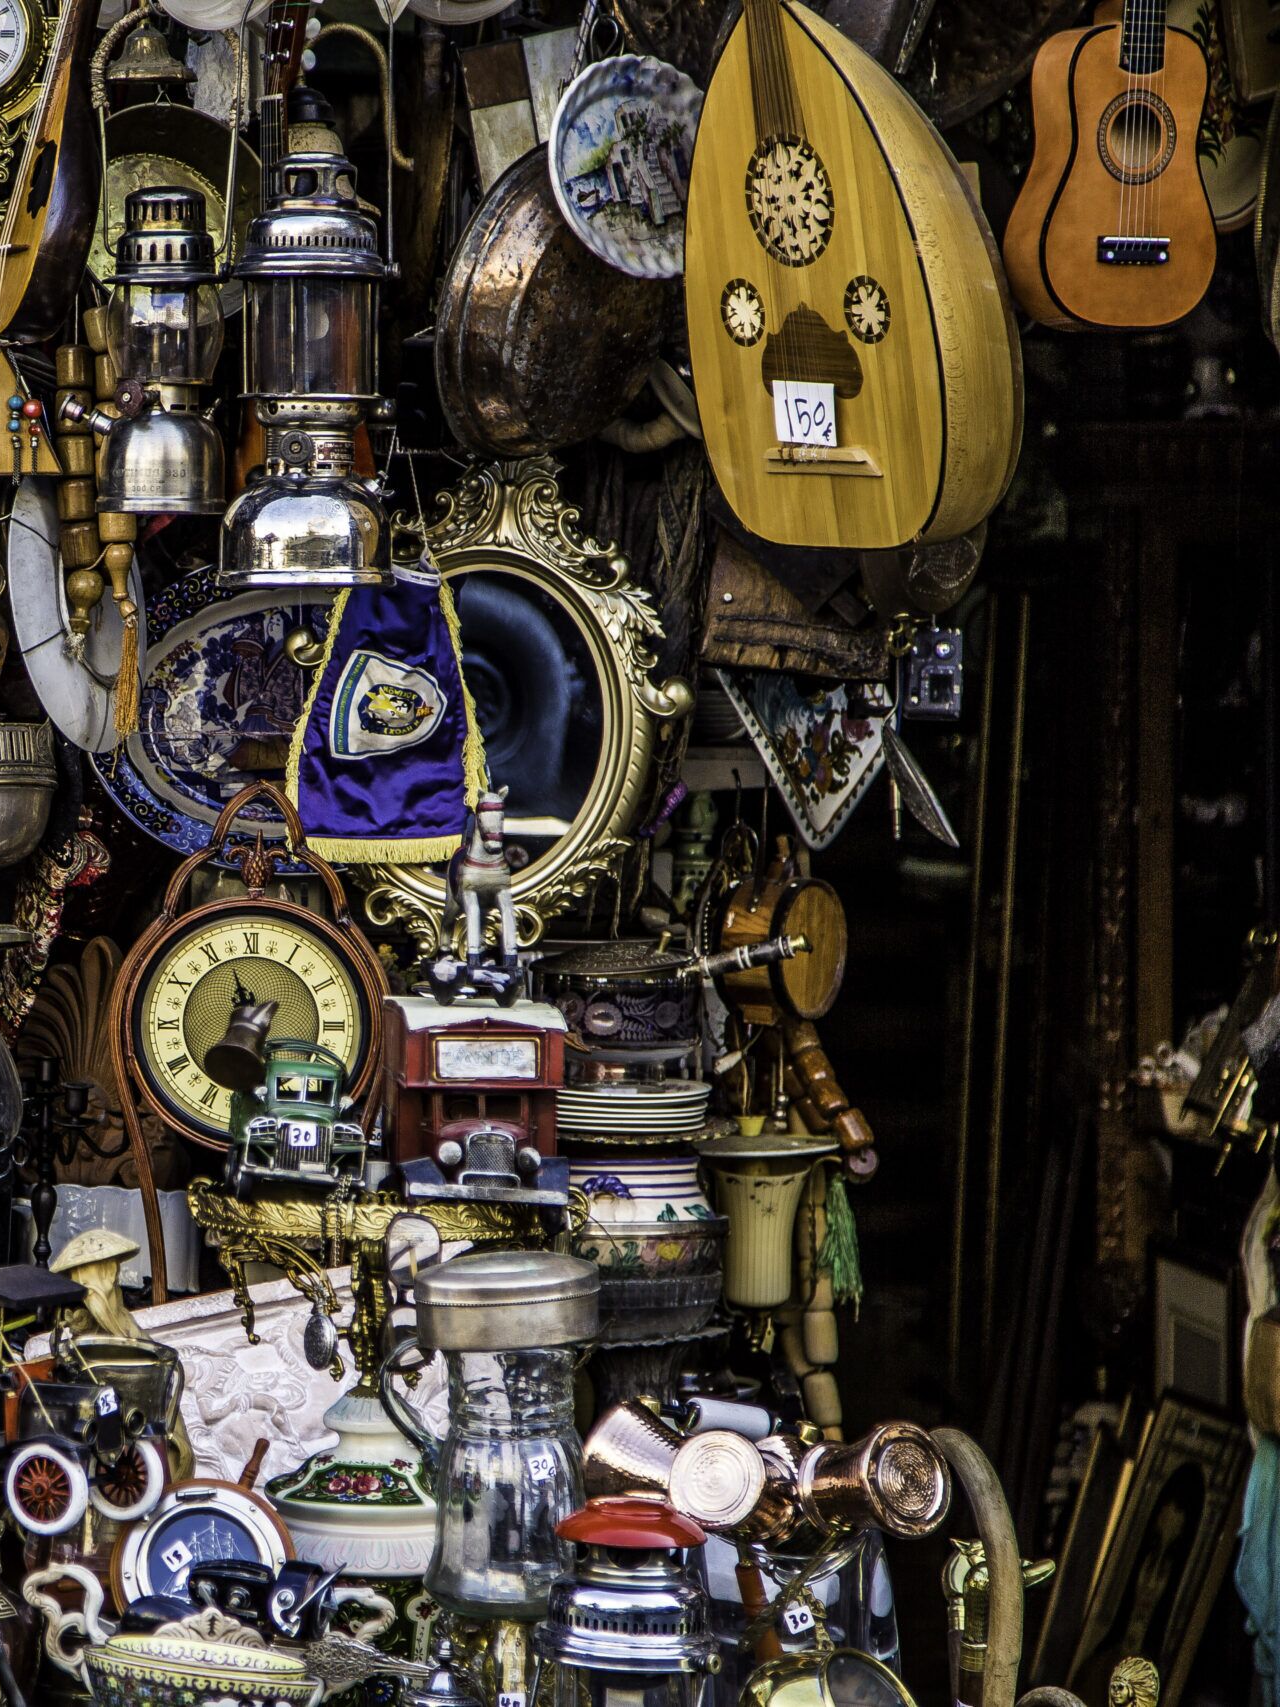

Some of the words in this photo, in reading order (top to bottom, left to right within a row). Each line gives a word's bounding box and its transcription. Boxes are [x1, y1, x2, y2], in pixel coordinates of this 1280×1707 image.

[0, 30, 15, 38] III
[243, 932, 259, 954] XII
[198, 942, 221, 966] XI
[285, 943, 301, 965] I
[167, 972, 192, 994] X
[312, 975, 337, 995] II
[157, 1016, 180, 1031] IX
[323, 1019, 345, 1034] III
[166, 1053, 191, 1079] VIII
[199, 1083, 220, 1109] VII
[293, 1127, 312, 1143] 30
[788, 1612, 809, 1630] 30
